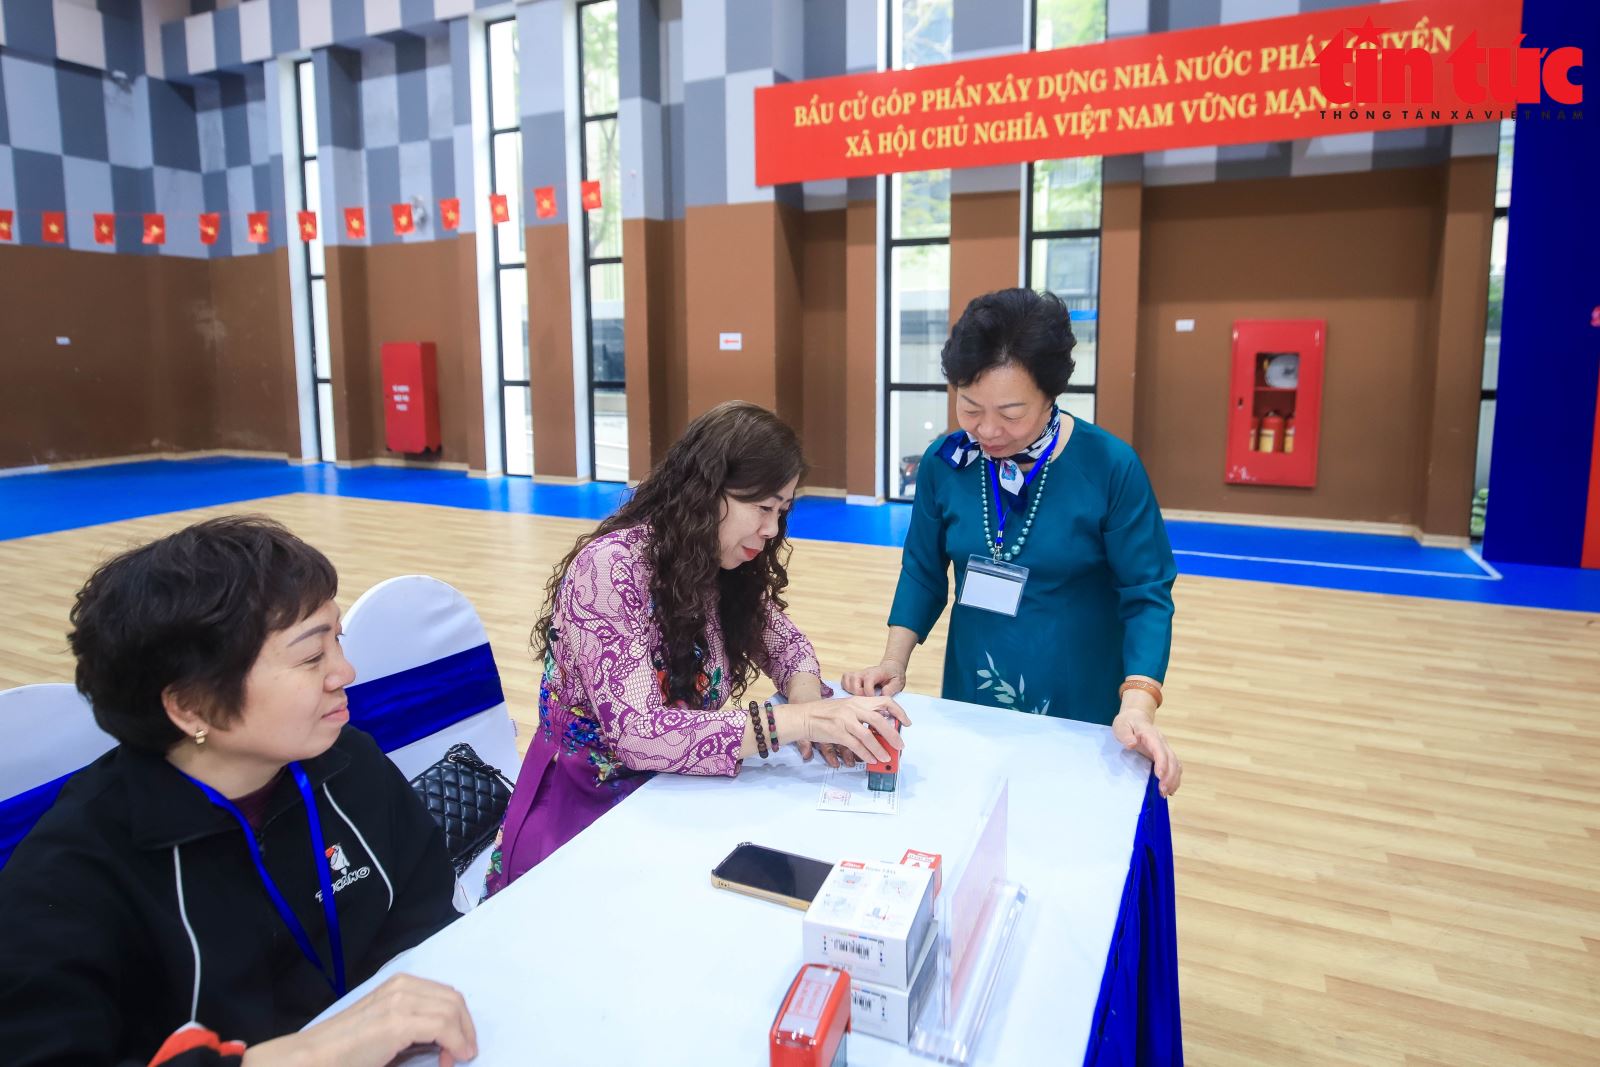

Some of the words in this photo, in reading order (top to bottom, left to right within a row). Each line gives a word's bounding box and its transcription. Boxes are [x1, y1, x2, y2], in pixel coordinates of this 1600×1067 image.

[838, 90, 869, 122] CỬ
[871, 87, 917, 117] GÓP
[986, 73, 1033, 106] XÂY
[1037, 68, 1108, 102] DỰNG
[1113, 54, 1170, 91] NHÀ
[1174, 45, 1252, 84] NƯỚC
[1259, 34, 1332, 73] PHÁ
[845, 129, 874, 158] XÃ
[877, 124, 917, 157] HỘI
[921, 116, 969, 149] CHỦ
[974, 111, 1049, 146] NGHĨA
[1053, 104, 1113, 140] VIỆT
[1116, 101, 1175, 131] NAM
[1180, 91, 1258, 124] VỮNG
[315, 866, 371, 903] TCANO
